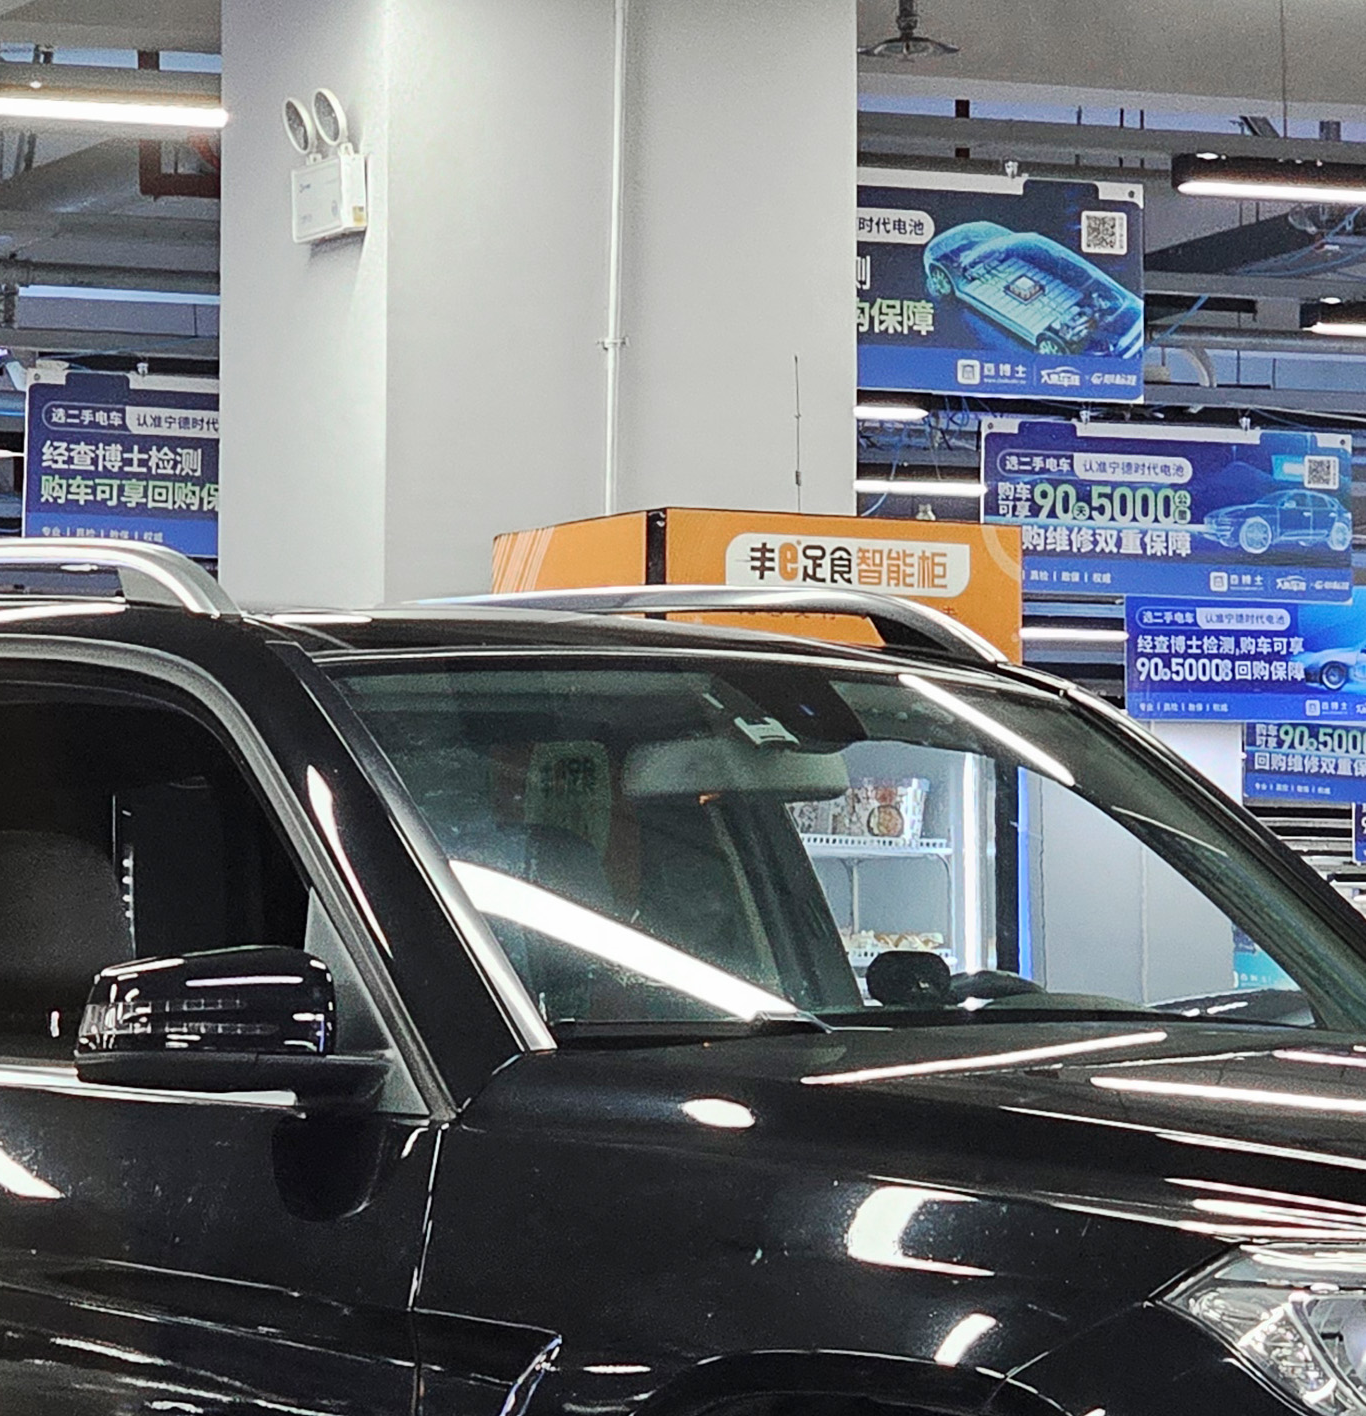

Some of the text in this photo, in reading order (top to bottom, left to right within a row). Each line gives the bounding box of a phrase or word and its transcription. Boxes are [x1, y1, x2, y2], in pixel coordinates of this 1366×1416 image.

[858, 216, 925, 236] 时代电池
[51, 407, 219, 432] 选二手电车 认准宁德时代
[41, 440, 202, 476] 经查博士检测
[1004, 455, 1185, 478] 选二手电车 认准宁德时代电池
[40, 474, 219, 512] 购车可享回购保
[1022, 525, 1192, 558] 购维修双重保障
